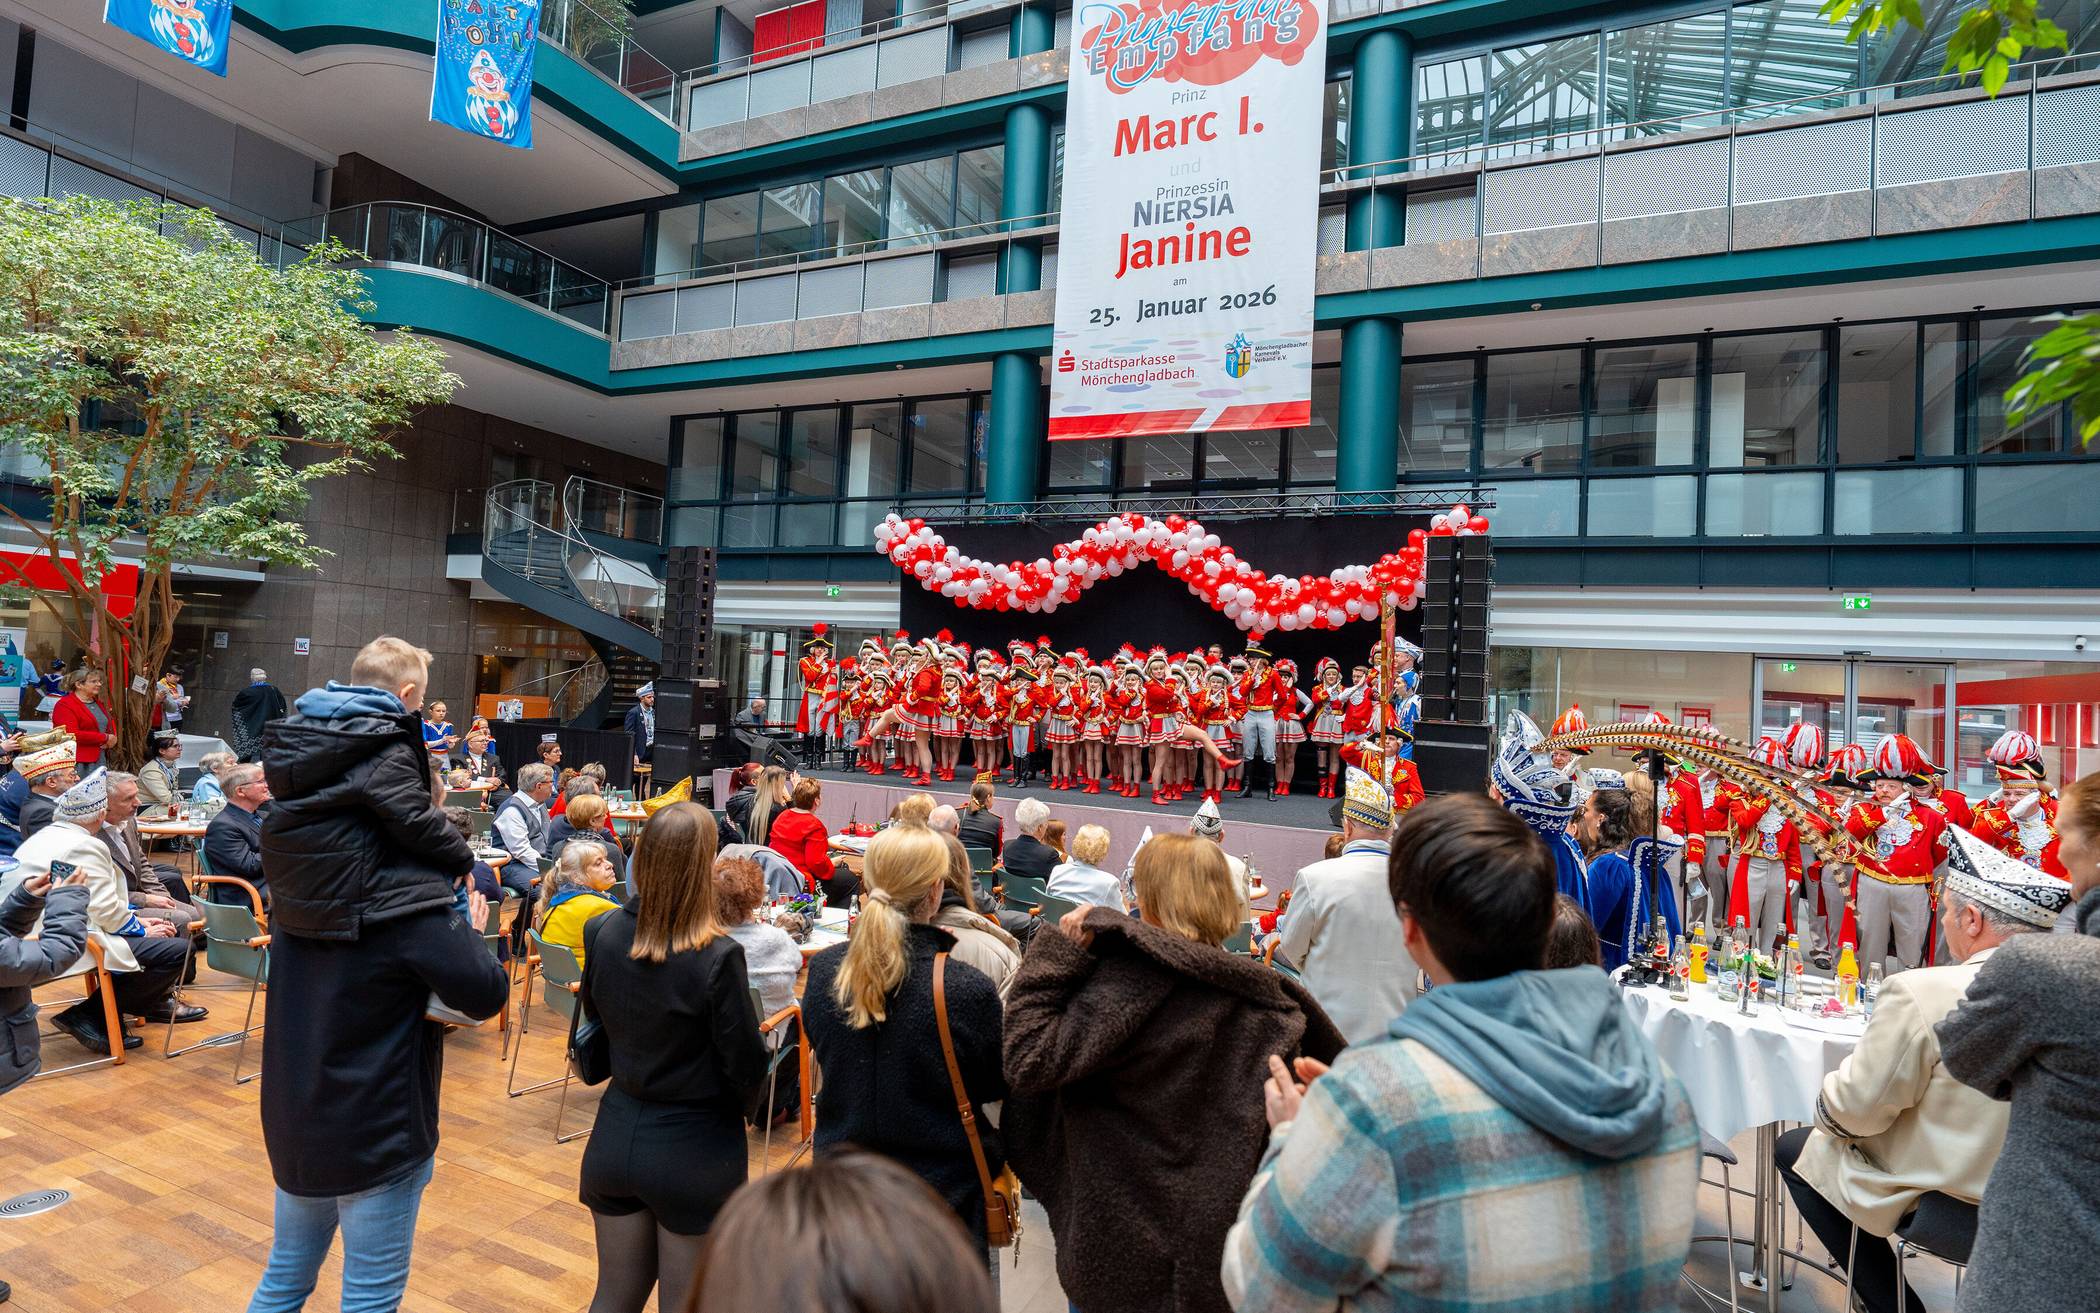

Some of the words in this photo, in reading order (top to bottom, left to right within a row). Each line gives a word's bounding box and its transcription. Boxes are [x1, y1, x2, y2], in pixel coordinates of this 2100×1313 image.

[1090, 6, 1303, 75] Empfang
[1171, 88, 1207, 105] Prinz
[1113, 110, 1218, 157] Marc
[1238, 95, 1264, 135] I.
[1170, 157, 1201, 177] und
[1156, 178, 1229, 200] Prinzessin
[1133, 193, 1235, 228] NIERSIA
[1114, 221, 1251, 280] Janine
[1173, 276, 1187, 286] am
[1089, 307, 1121, 327] 25.
[1136, 296, 1208, 322] Januar
[1219, 284, 1277, 310] 2026
[1081, 354, 1176, 371] Stadtsparkasse
[1081, 366, 1195, 387] Mönchengladbach
